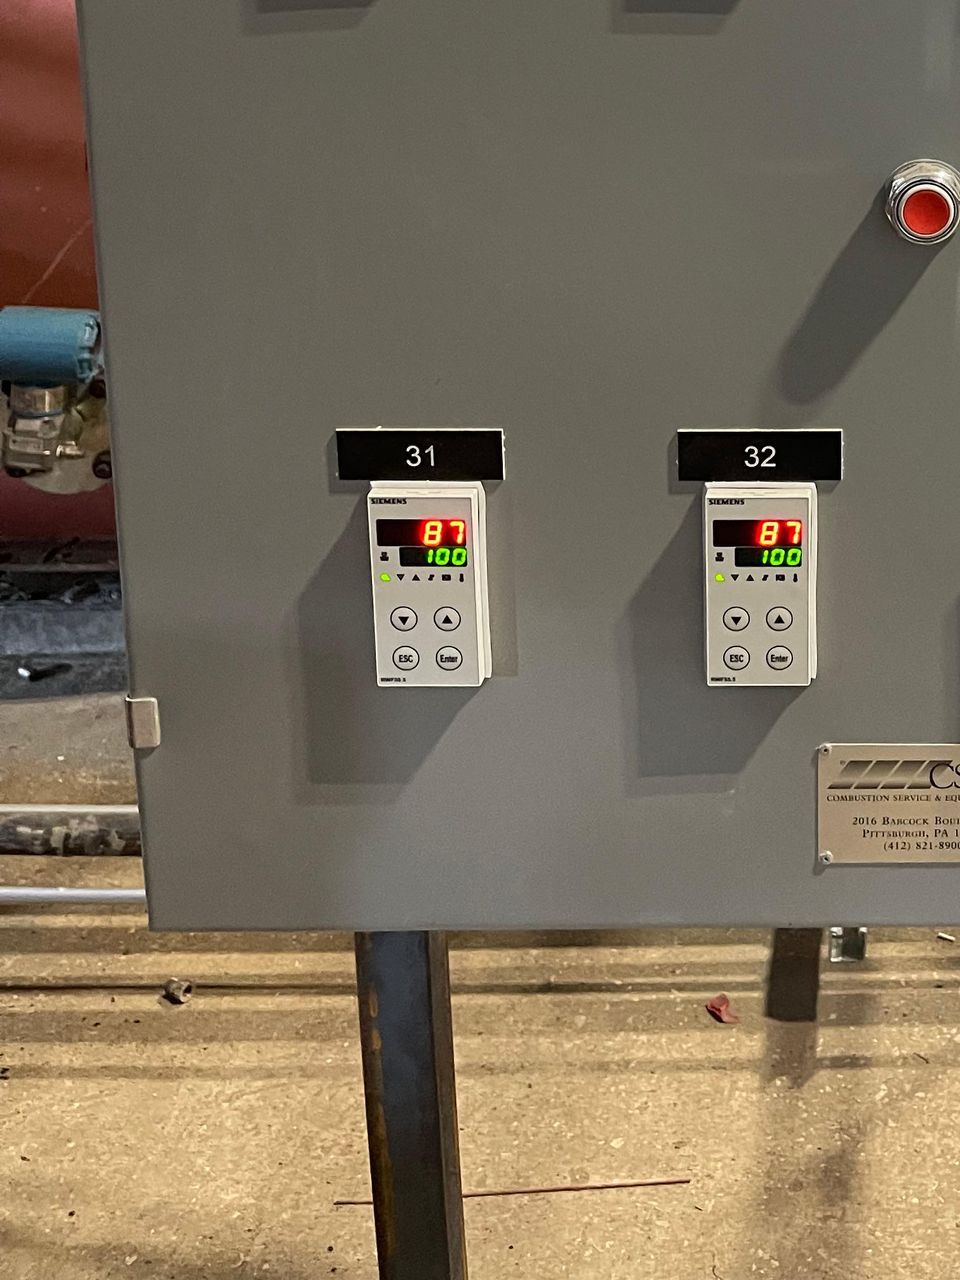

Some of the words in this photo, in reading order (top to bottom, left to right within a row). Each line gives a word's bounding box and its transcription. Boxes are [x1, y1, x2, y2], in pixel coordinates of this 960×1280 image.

[405, 445, 436, 467] 31
[744, 445, 777, 468] 32
[708, 498, 745, 506] SIEMENS
[423, 521, 465, 546] 87
[759, 521, 802, 545] 87
[427, 548, 467, 566] 100
[762, 548, 802, 566] 100
[398, 654, 414, 663] ESC
[439, 654, 458, 663] Enter
[729, 654, 744, 663] ESC
[770, 654, 789, 663] Enter
[826, 794, 890, 802] COMBUSTION
[893, 794, 931, 802] SERVICE
[852, 816, 877, 826] 2016
[934, 828, 949, 838] PA
[883, 841, 911, 851] (412)
